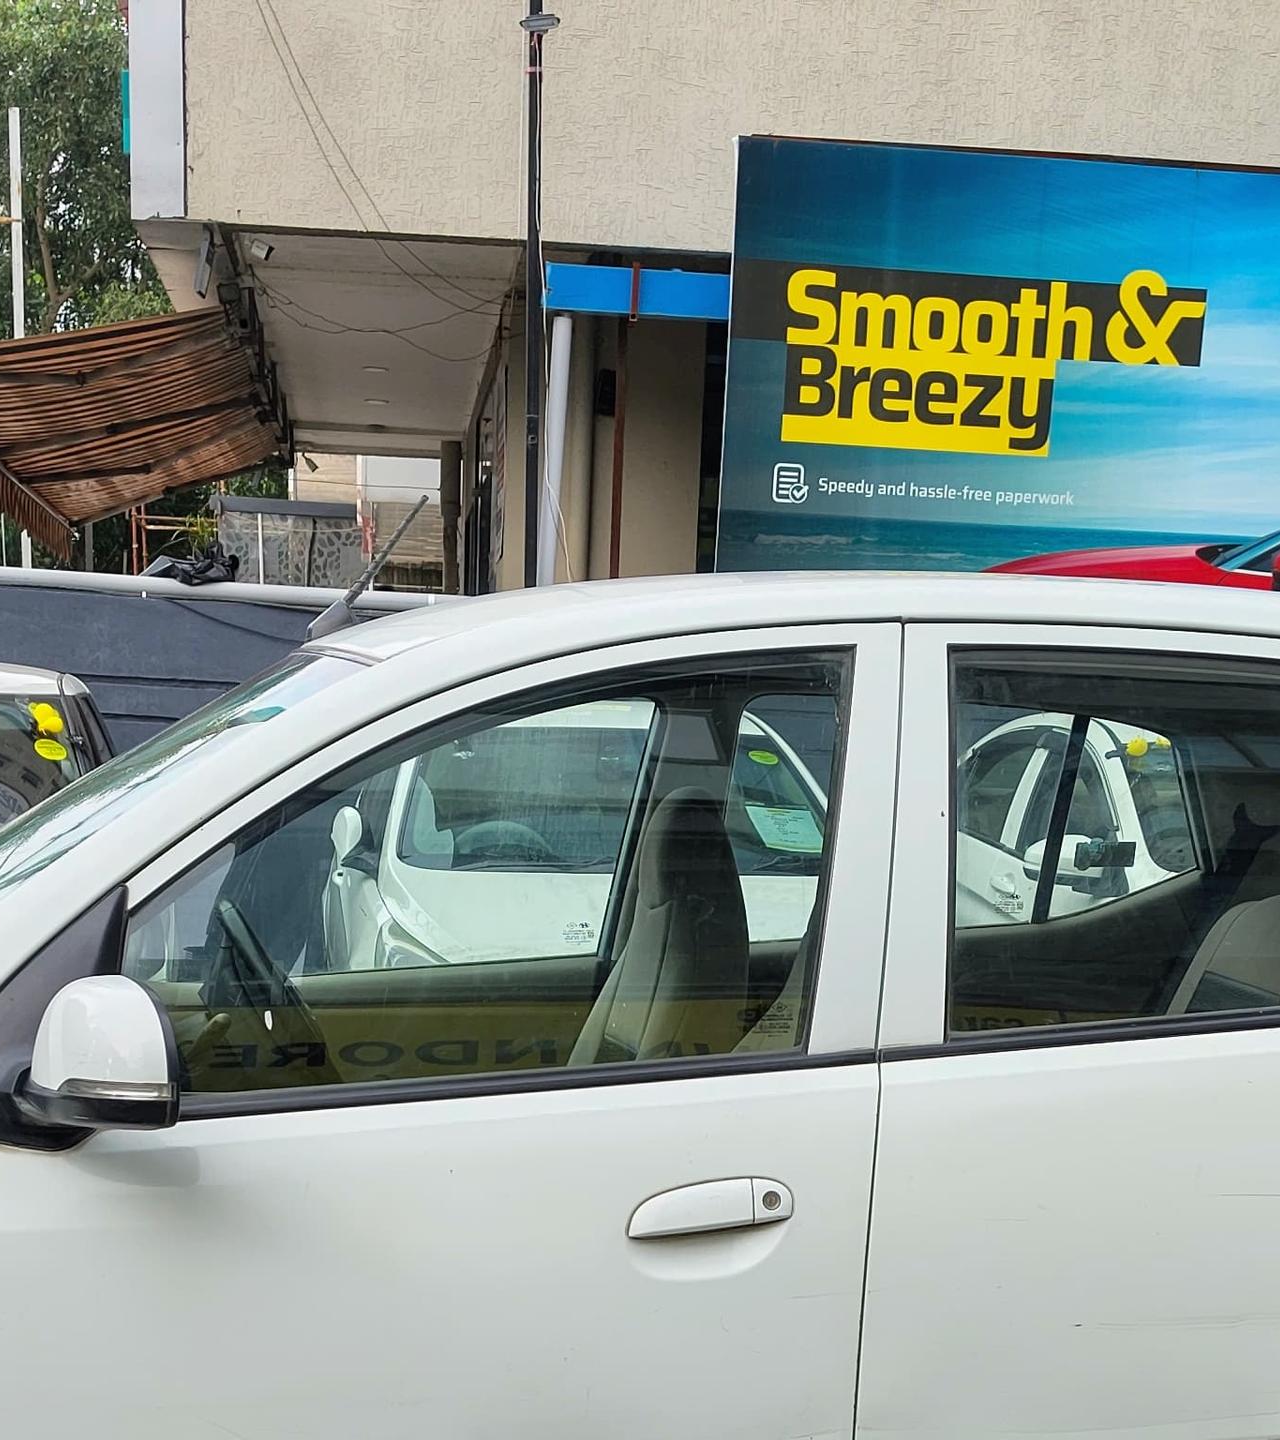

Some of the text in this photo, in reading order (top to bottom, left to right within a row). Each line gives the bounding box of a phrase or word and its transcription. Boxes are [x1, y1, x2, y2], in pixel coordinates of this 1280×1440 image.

[786, 269, 1207, 366] Smooth &
[783, 344, 1055, 451] Breezy
[818, 477, 1074, 506] Speedy and hassle-free paperwork
